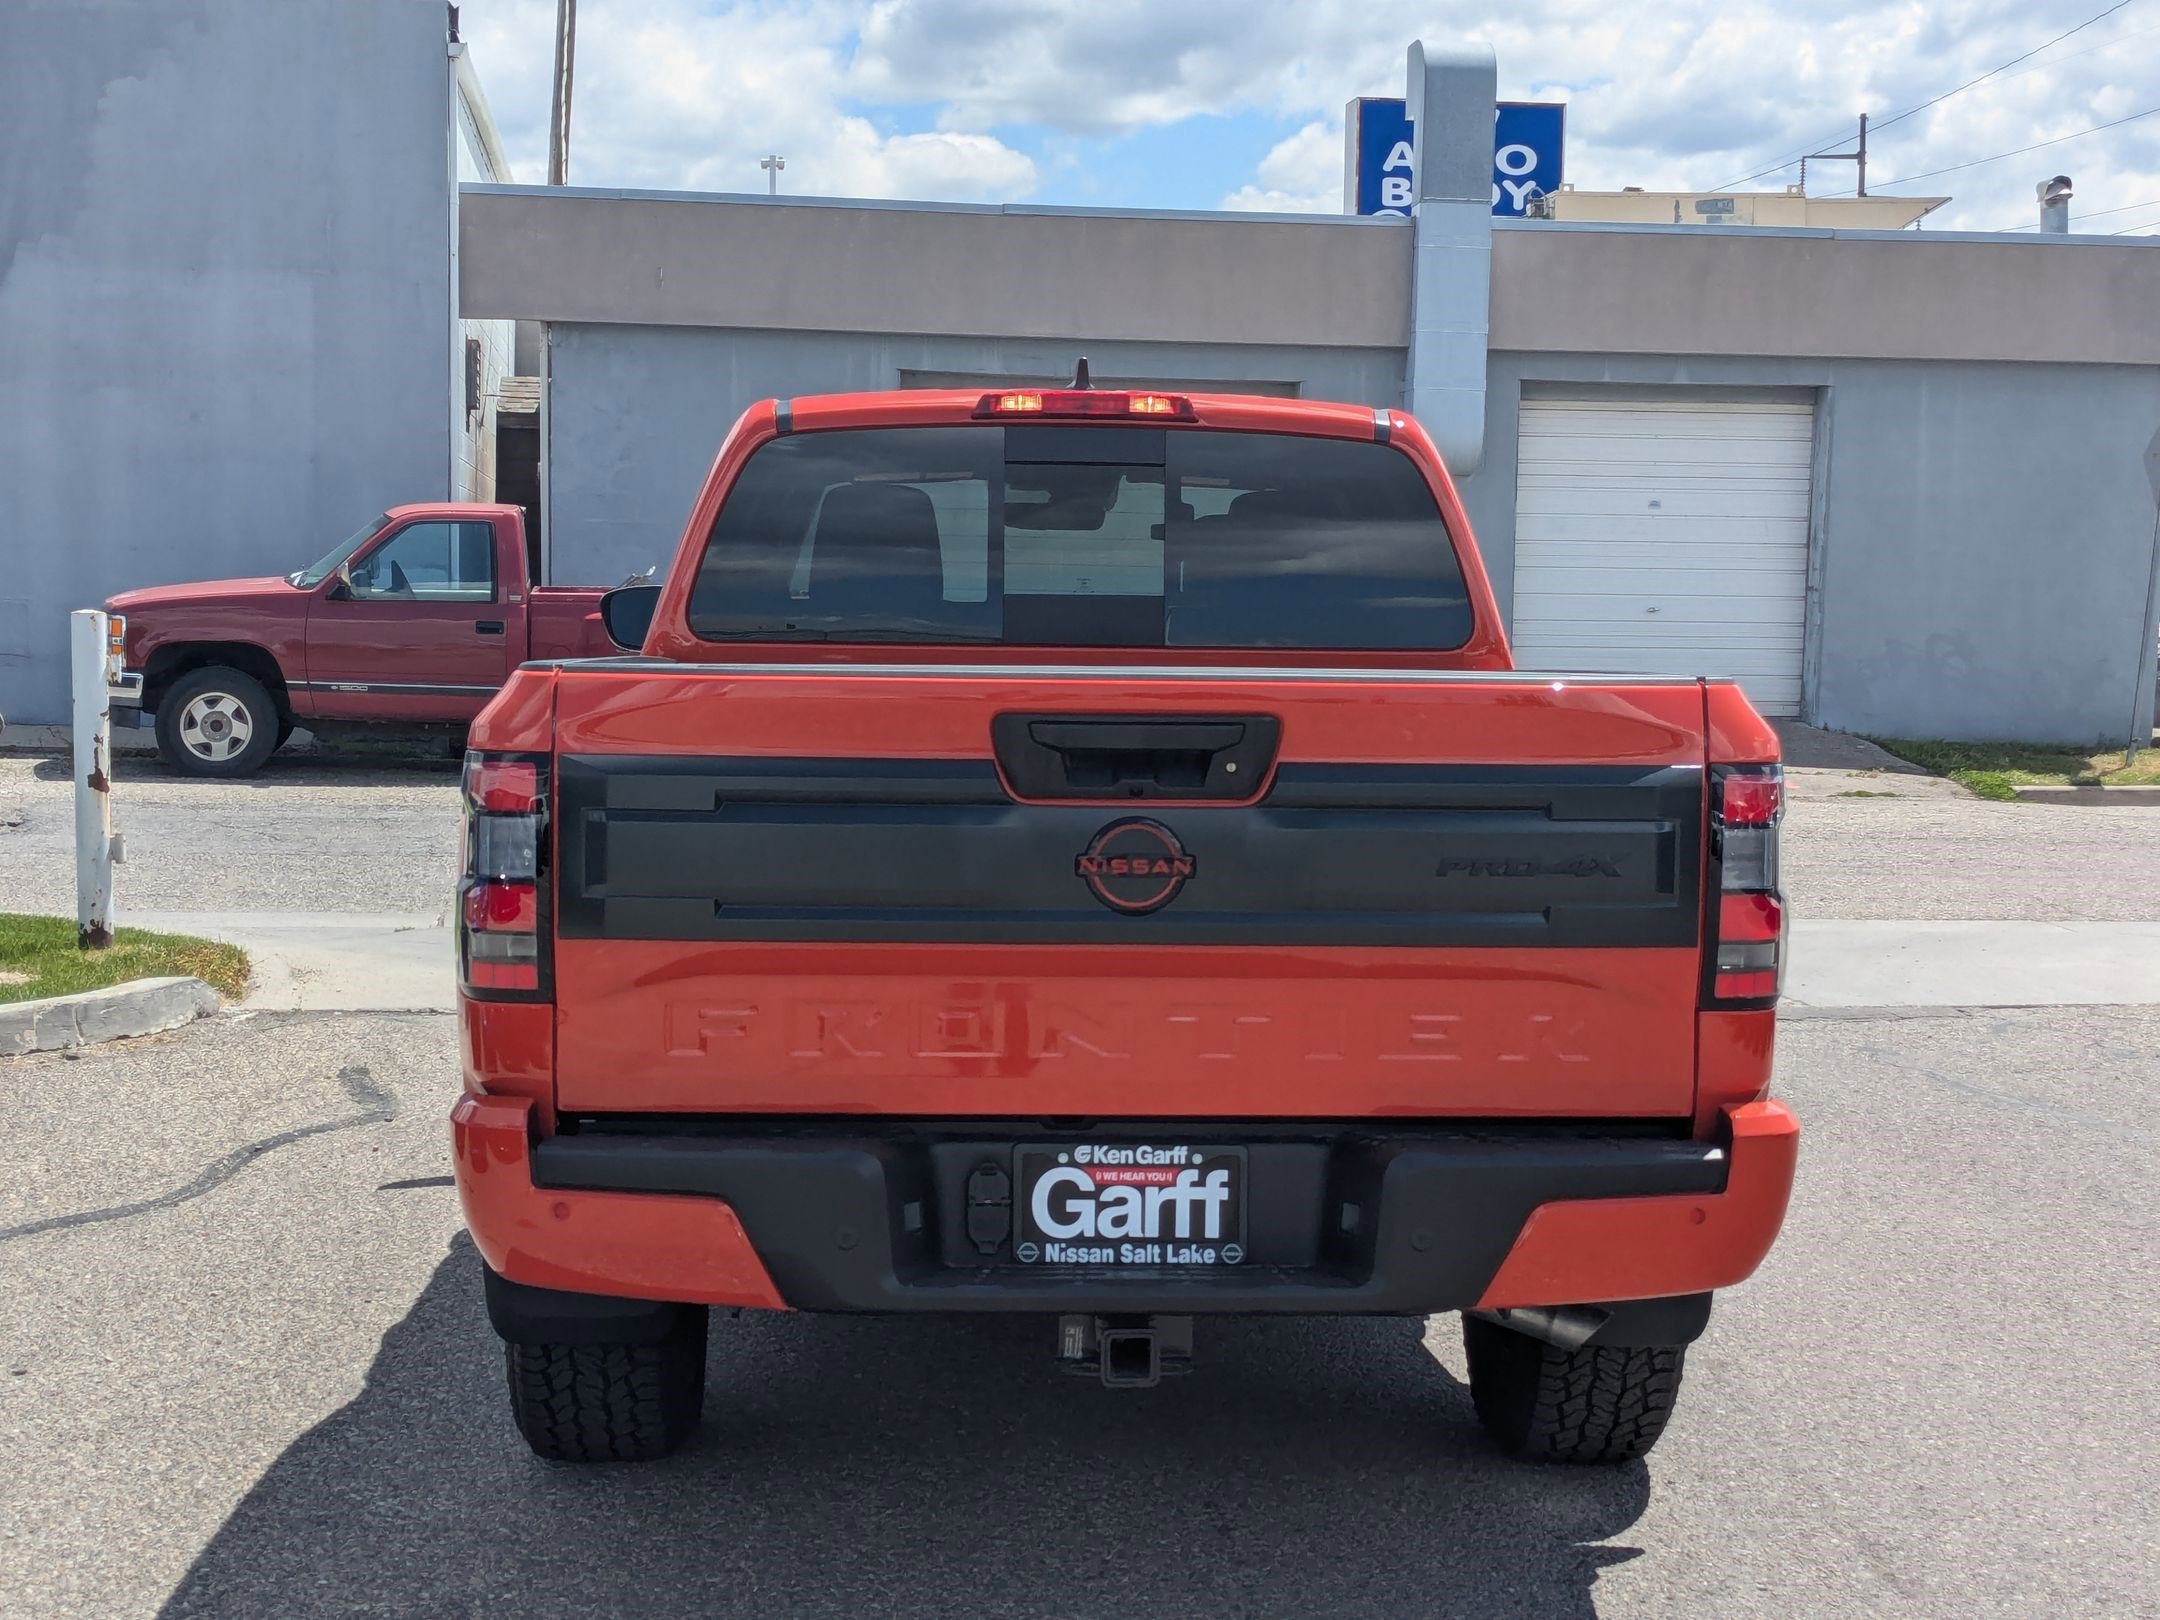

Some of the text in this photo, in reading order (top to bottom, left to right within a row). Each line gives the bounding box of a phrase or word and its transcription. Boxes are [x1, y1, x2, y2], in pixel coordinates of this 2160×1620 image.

[1383, 141, 1538, 176] AO
[1382, 177, 1537, 210] BY
[1079, 857, 1193, 875] NISSAN
[1435, 855, 1627, 878] PRO-4X
[663, 998, 1593, 1062] FRONTIER
[1093, 1145, 1188, 1164] Ken Garff
[1103, 1171, 1165, 1181] WE HEAR YOU
[1031, 1166, 1229, 1239] Garff
[1045, 1243, 1216, 1264] Nissan Salt Lake
